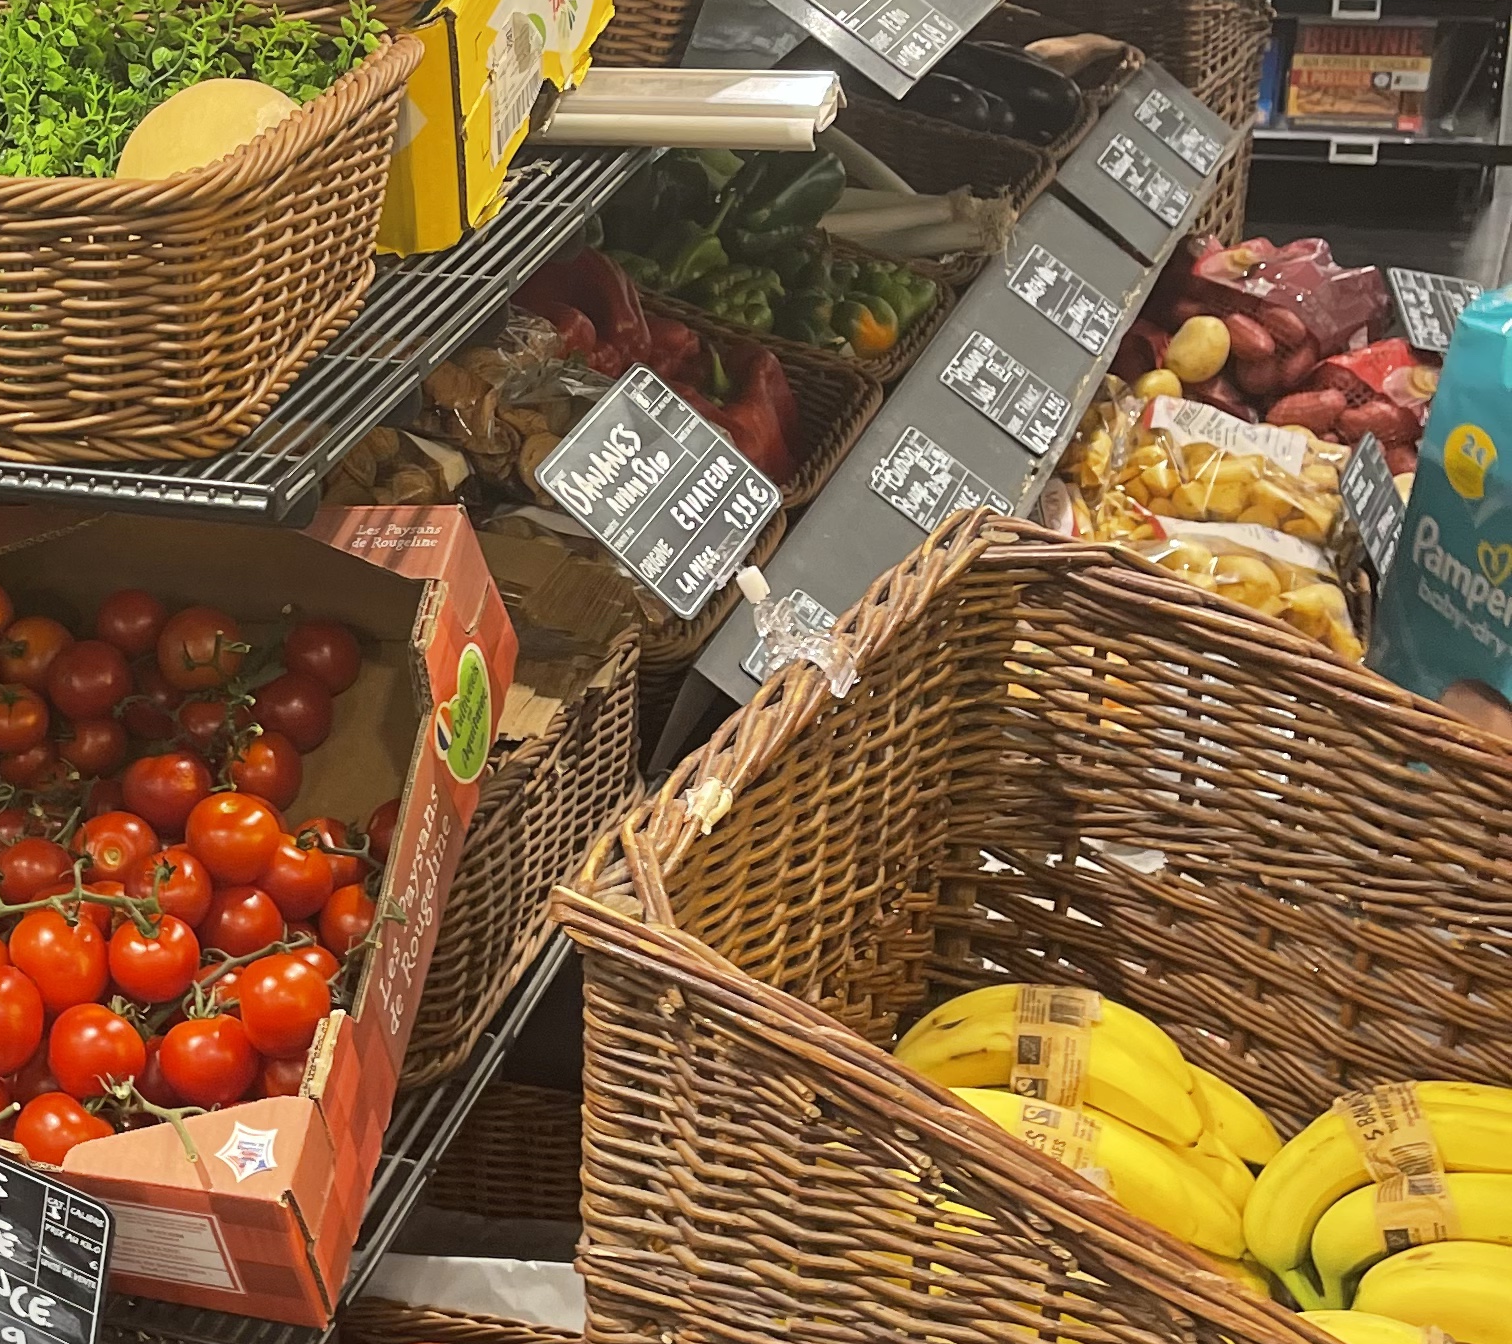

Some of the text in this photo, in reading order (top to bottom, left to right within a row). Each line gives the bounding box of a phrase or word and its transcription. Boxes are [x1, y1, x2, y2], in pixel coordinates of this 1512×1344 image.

[558, 423, 642, 516] BANANES
[746, 478, 769, 503] €
[351, 535, 440, 550] de Rougeline
[356, 522, 443, 539] Les Paysans
[639, 538, 674, 579] ORIGINE
[378, 782, 439, 1011] Les Paysans
[388, 813, 452, 1035] de Rougeline
[70, 1206, 105, 1229] CALIBRE
[79, 1239, 101, 1255] KILO
